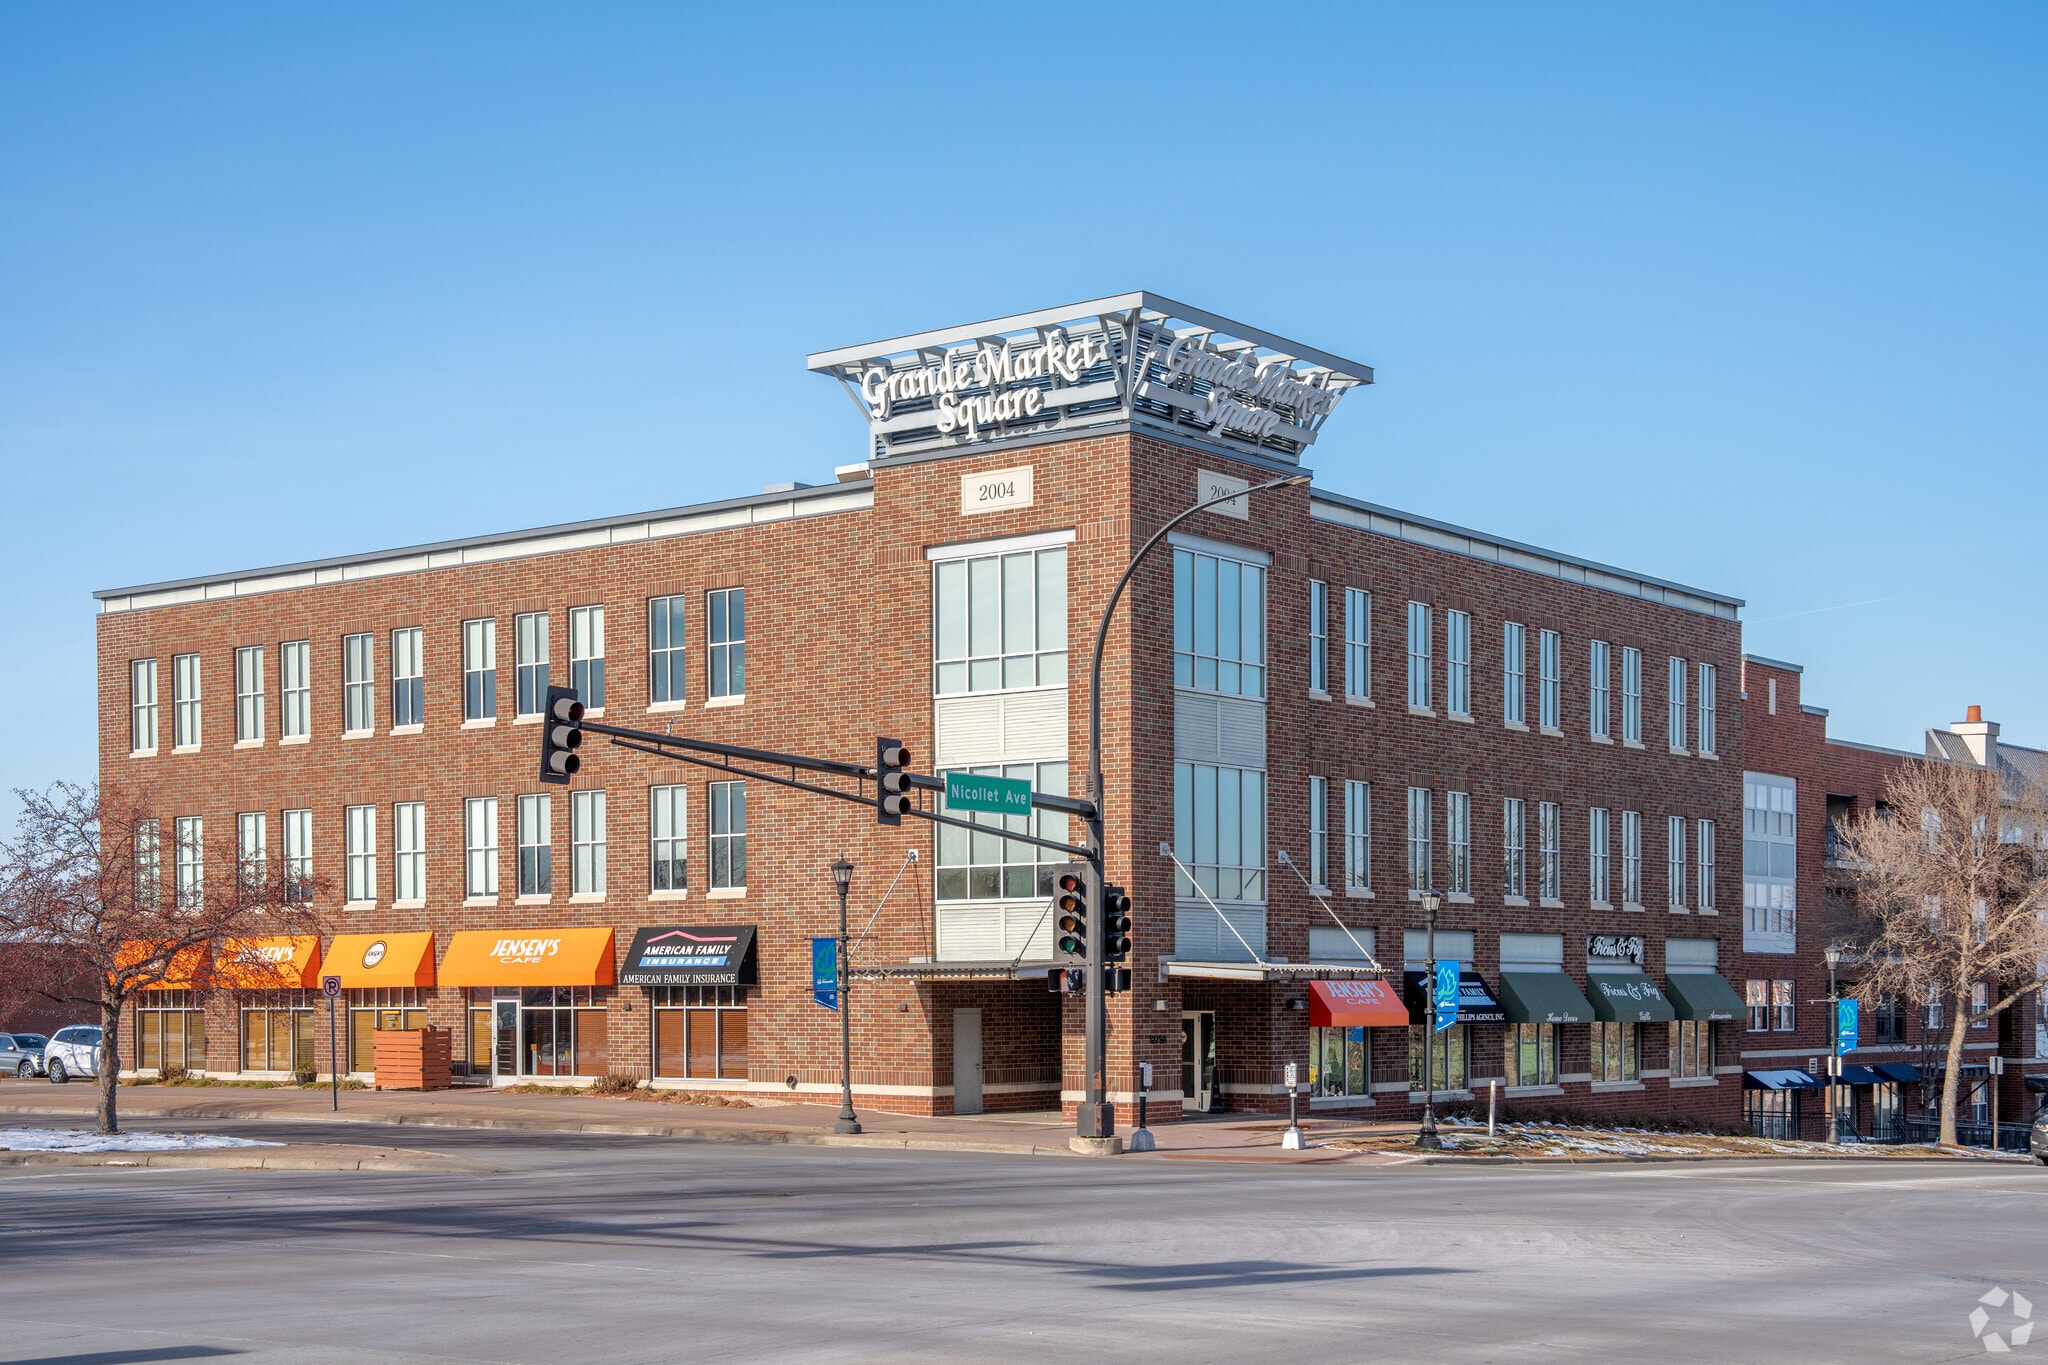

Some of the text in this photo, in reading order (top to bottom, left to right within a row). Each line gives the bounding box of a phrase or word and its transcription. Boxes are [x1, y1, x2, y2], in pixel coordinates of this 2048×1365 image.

[861, 328, 1103, 418] Grande Market
[1160, 335, 1334, 421] Grande Market
[936, 386, 1043, 440] Square
[1196, 386, 1281, 438] Square
[979, 481, 1015, 501] 2004
[951, 784, 1027, 805] Nicollet Ave
[489, 938, 561, 957] JENSEN'S
[643, 944, 731, 955] AMERICAN FAMILY
[1592, 936, 1643, 963] Ficus & Fig
[499, 956, 542, 964] CAFE
[646, 957, 719, 965] INSURANCE
[622, 973, 736, 985] AMERICAN FAMILY INSURANCE
[1324, 980, 1385, 998] JENSEN'S
[1461, 987, 1487, 997] FAMILY
[1600, 982, 1660, 1001] Ficus & Fig
